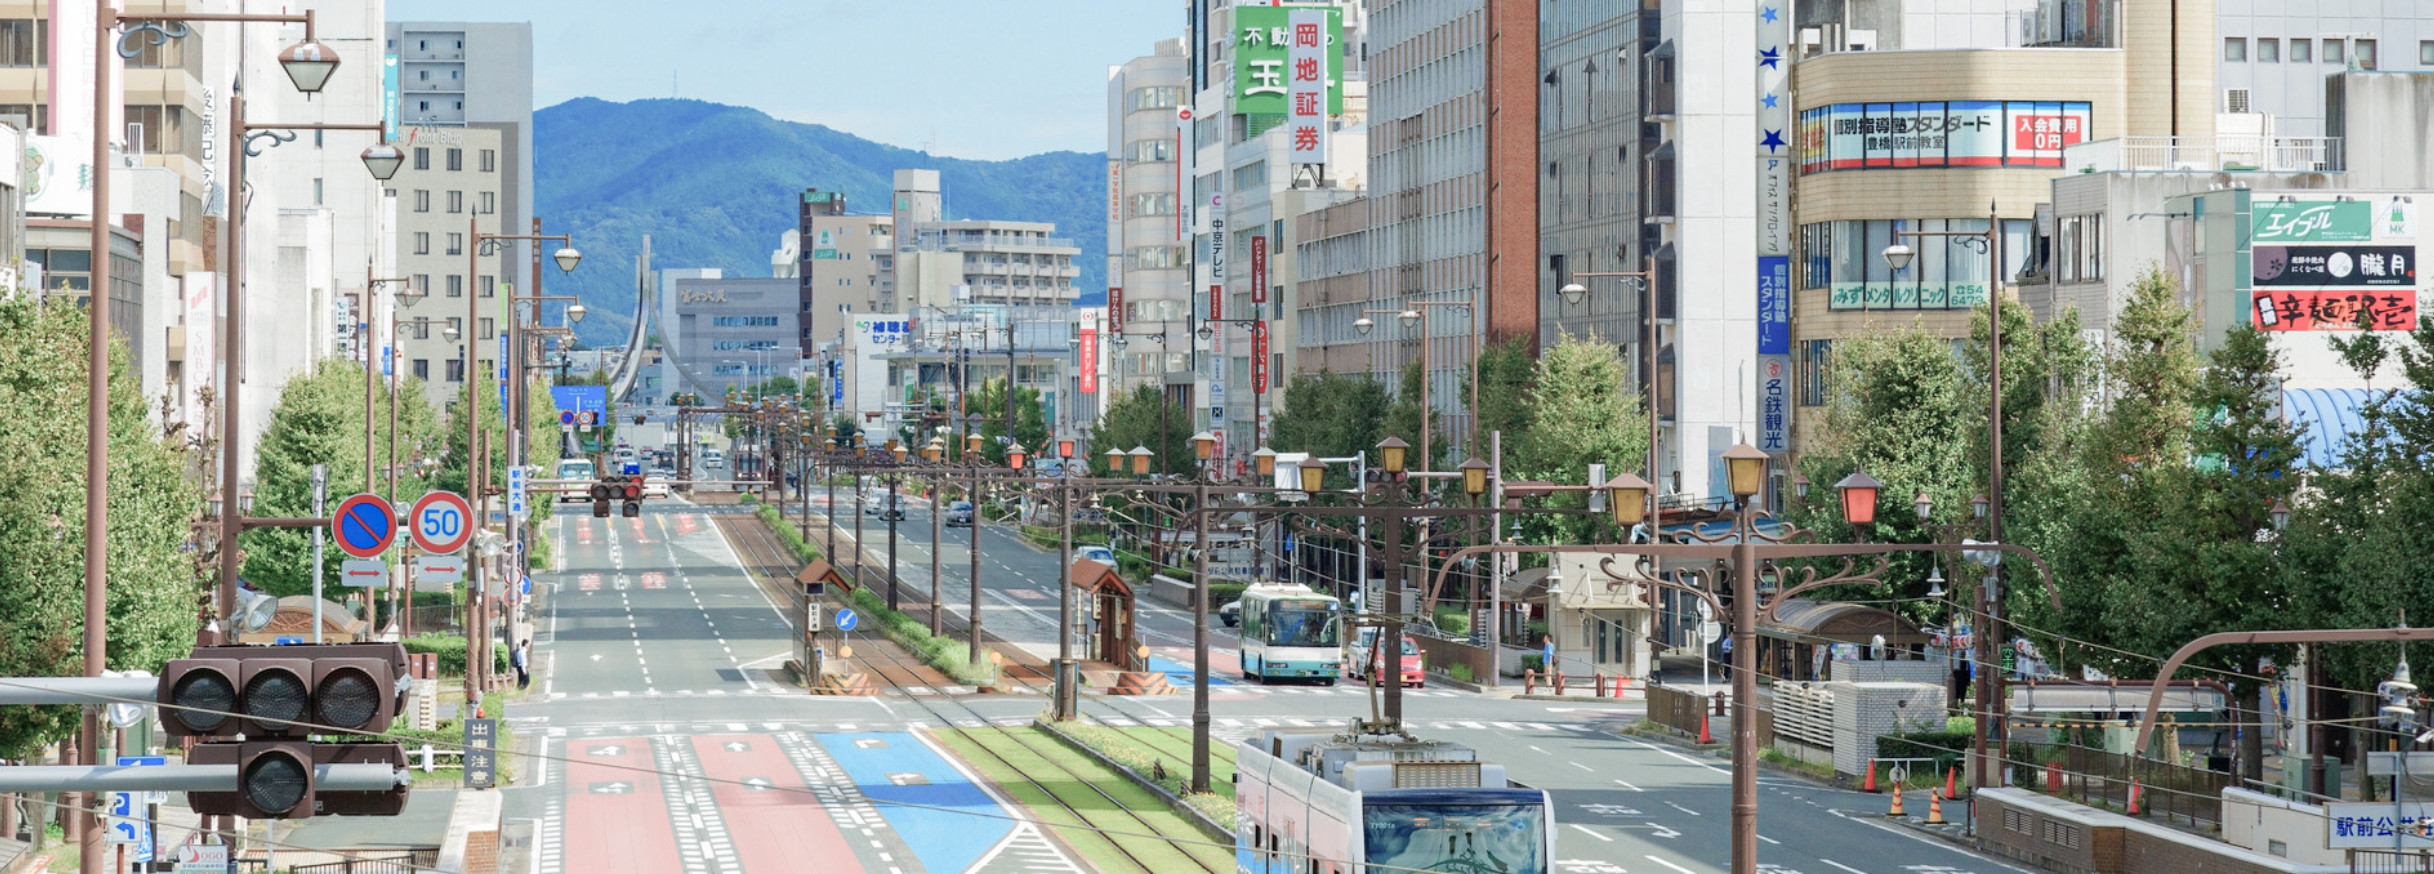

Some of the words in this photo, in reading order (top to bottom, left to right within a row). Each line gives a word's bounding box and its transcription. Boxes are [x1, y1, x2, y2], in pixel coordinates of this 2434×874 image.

[1295, 23, 1319, 152] 岡地証券
[1834, 115, 1991, 136] 個別指導塾スタンダード
[2019, 117, 2077, 133] 入会費用
[1866, 135, 1945, 151] 豊橋駅前教室
[2035, 133, 2062, 150] 0円
[2259, 205, 2335, 237] エイブル
[2389, 224, 2405, 234] MK
[1212, 218, 1223, 278] 中京テレビ
[2359, 253, 2406, 276] 朧月
[1774, 264, 1787, 323] 個別指導塾
[1966, 285, 1984, 295] 54
[1761, 276, 1773, 346] スタンダード
[872, 334, 902, 344] センター
[1765, 378, 1783, 450] 名鉄観光
[511, 470, 522, 512] 駅前大通
[424, 509, 459, 537] 50
